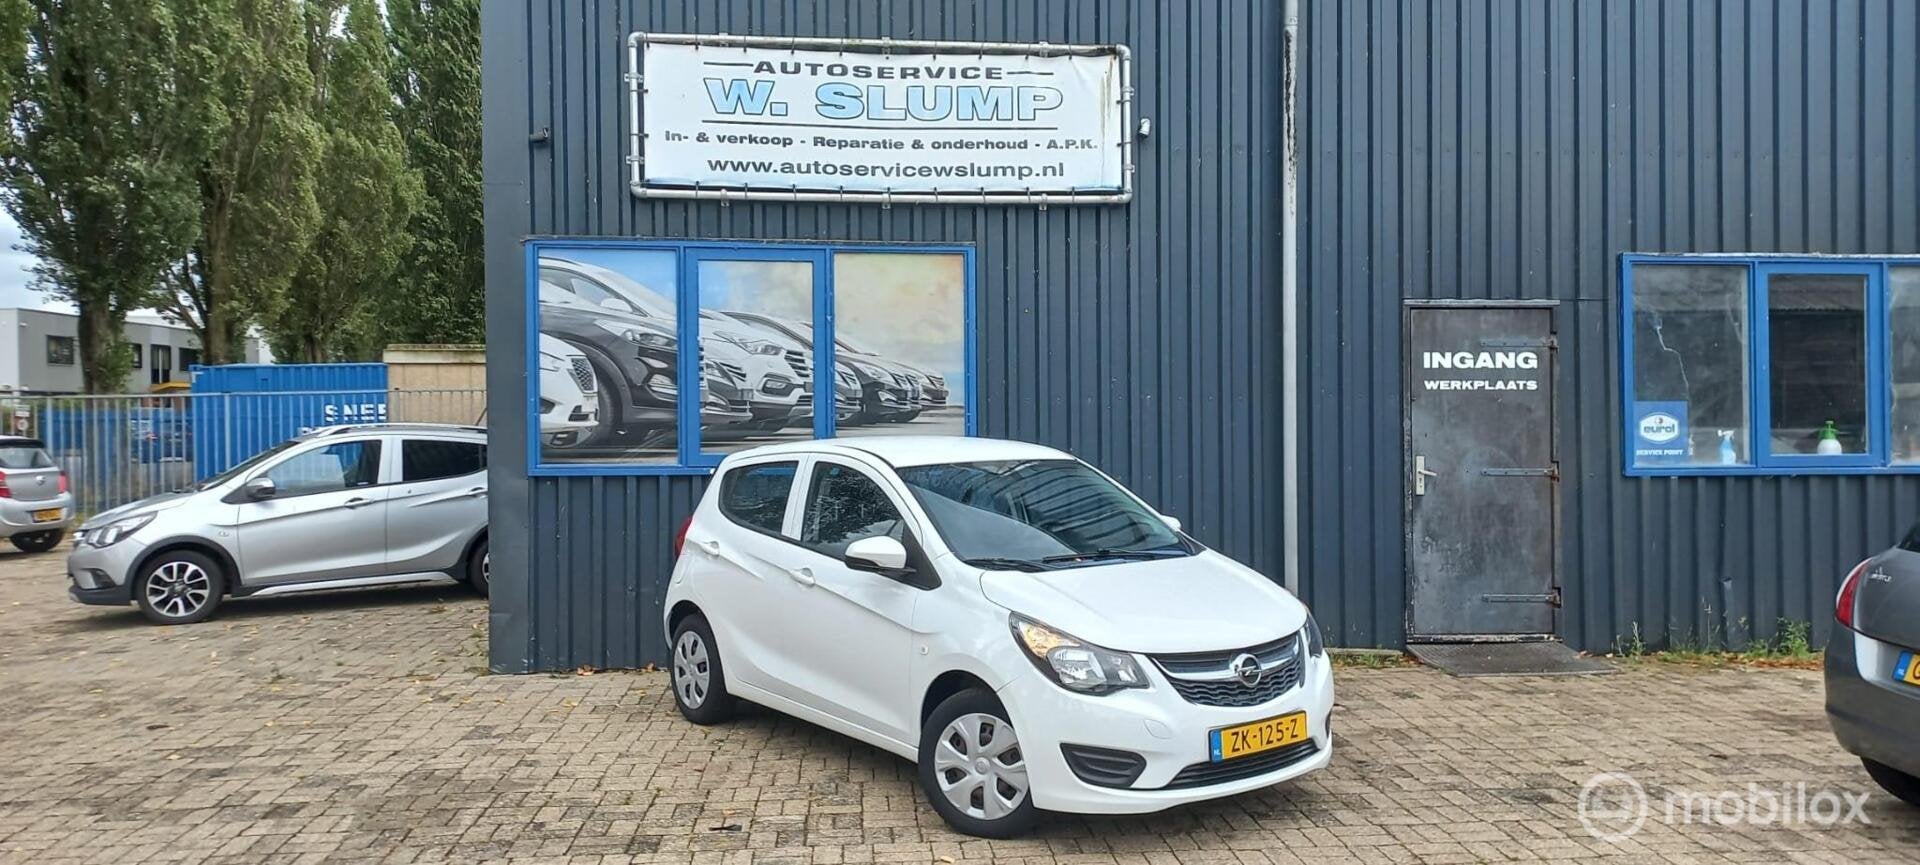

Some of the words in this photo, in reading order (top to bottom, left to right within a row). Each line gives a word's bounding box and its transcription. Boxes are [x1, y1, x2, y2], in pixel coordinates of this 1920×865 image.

[753, 61, 1003, 80] AUTOSERVICE
[703, 77, 788, 117] W.
[815, 81, 1063, 121] SLUMP
[665, 130, 689, 142] In-
[696, 132, 709, 143] &
[716, 133, 793, 148] verkoop
[813, 136, 904, 151] Reparatie
[911, 139, 924, 150] &
[931, 139, 1028, 150] onderhoud
[1046, 138, 1098, 150] A.P.K.
[707, 159, 1064, 181] www.autoservicewslump.nl
[1423, 351, 1538, 369] INGANG
[1424, 380, 1538, 391] WERKPLAATS
[1643, 423, 1675, 433] eurol
[1231, 718, 1299, 753] ZK-125-Z
